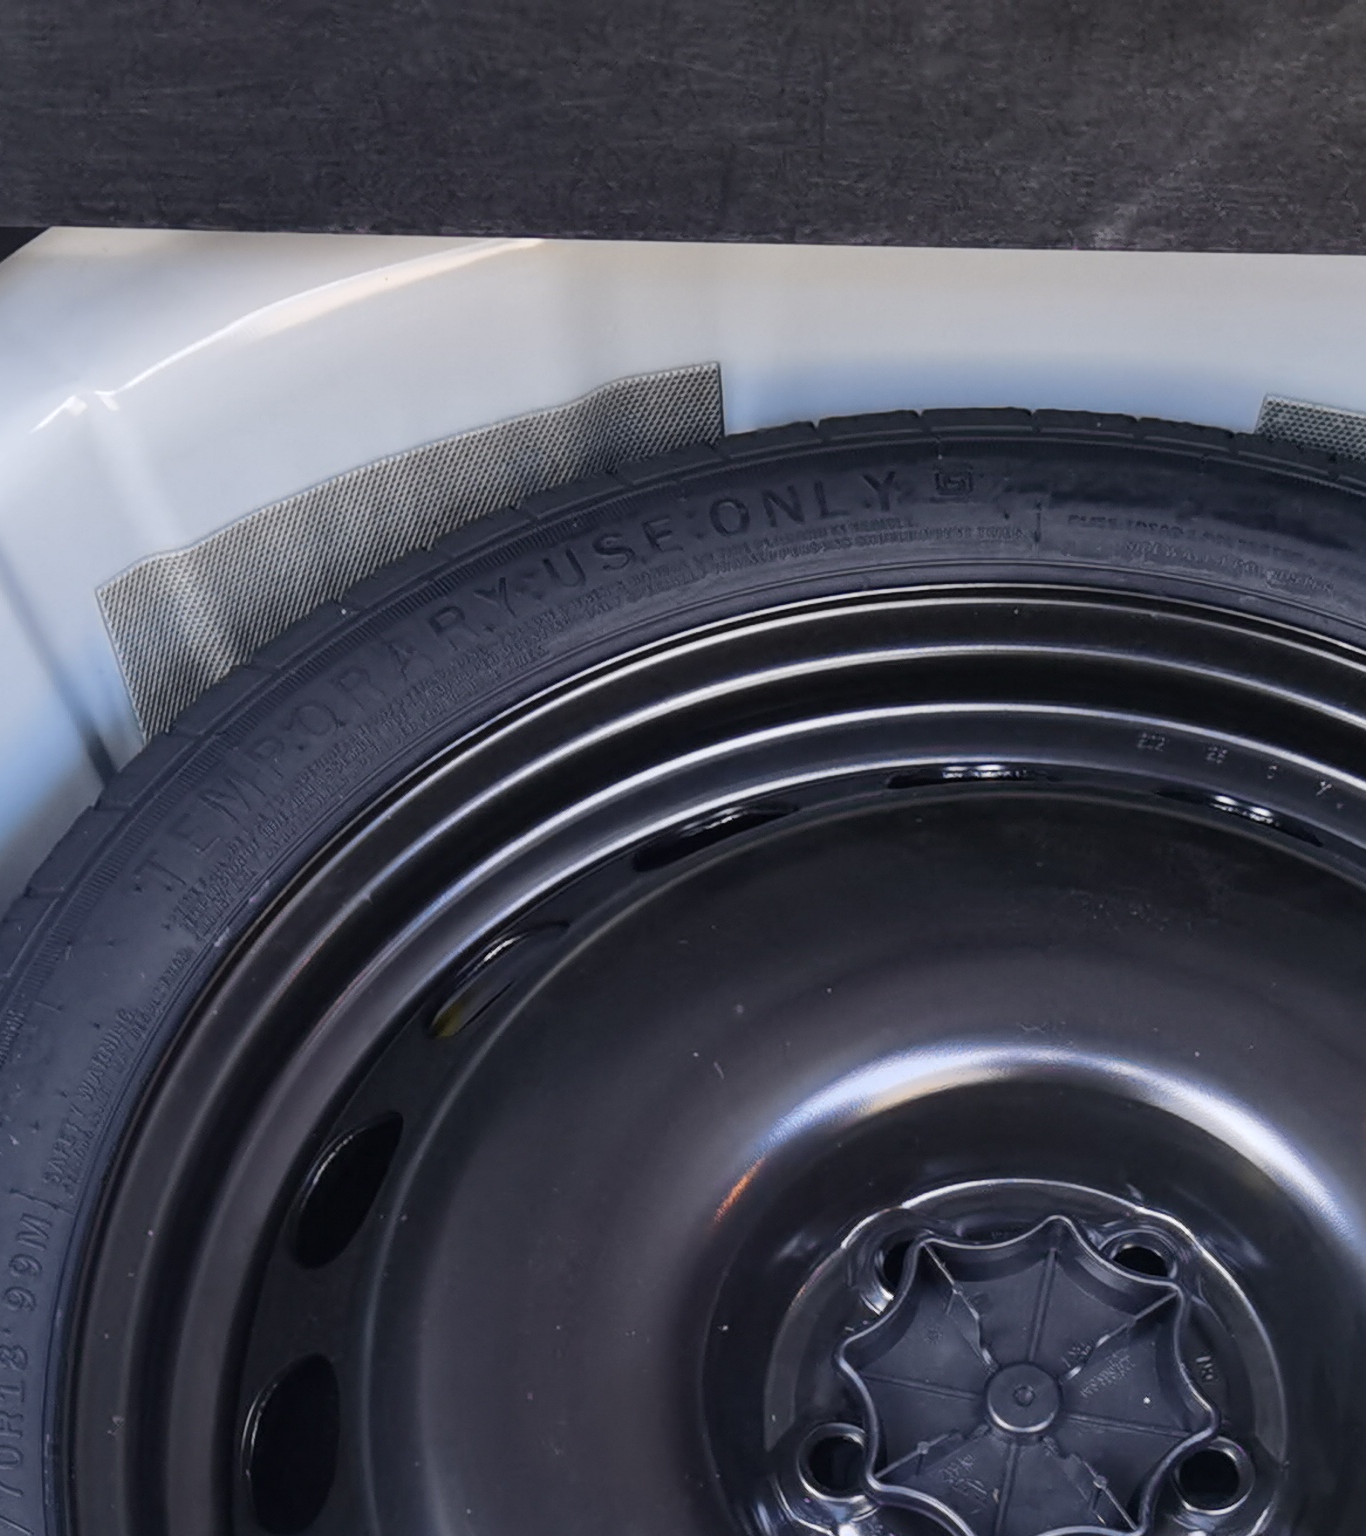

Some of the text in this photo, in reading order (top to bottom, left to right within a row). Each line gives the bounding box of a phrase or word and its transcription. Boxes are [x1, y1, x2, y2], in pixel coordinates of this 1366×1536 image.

[127, 575, 530, 899] TEMPORARY
[538, 514, 687, 594] USE
[700, 470, 906, 541] ONLY
